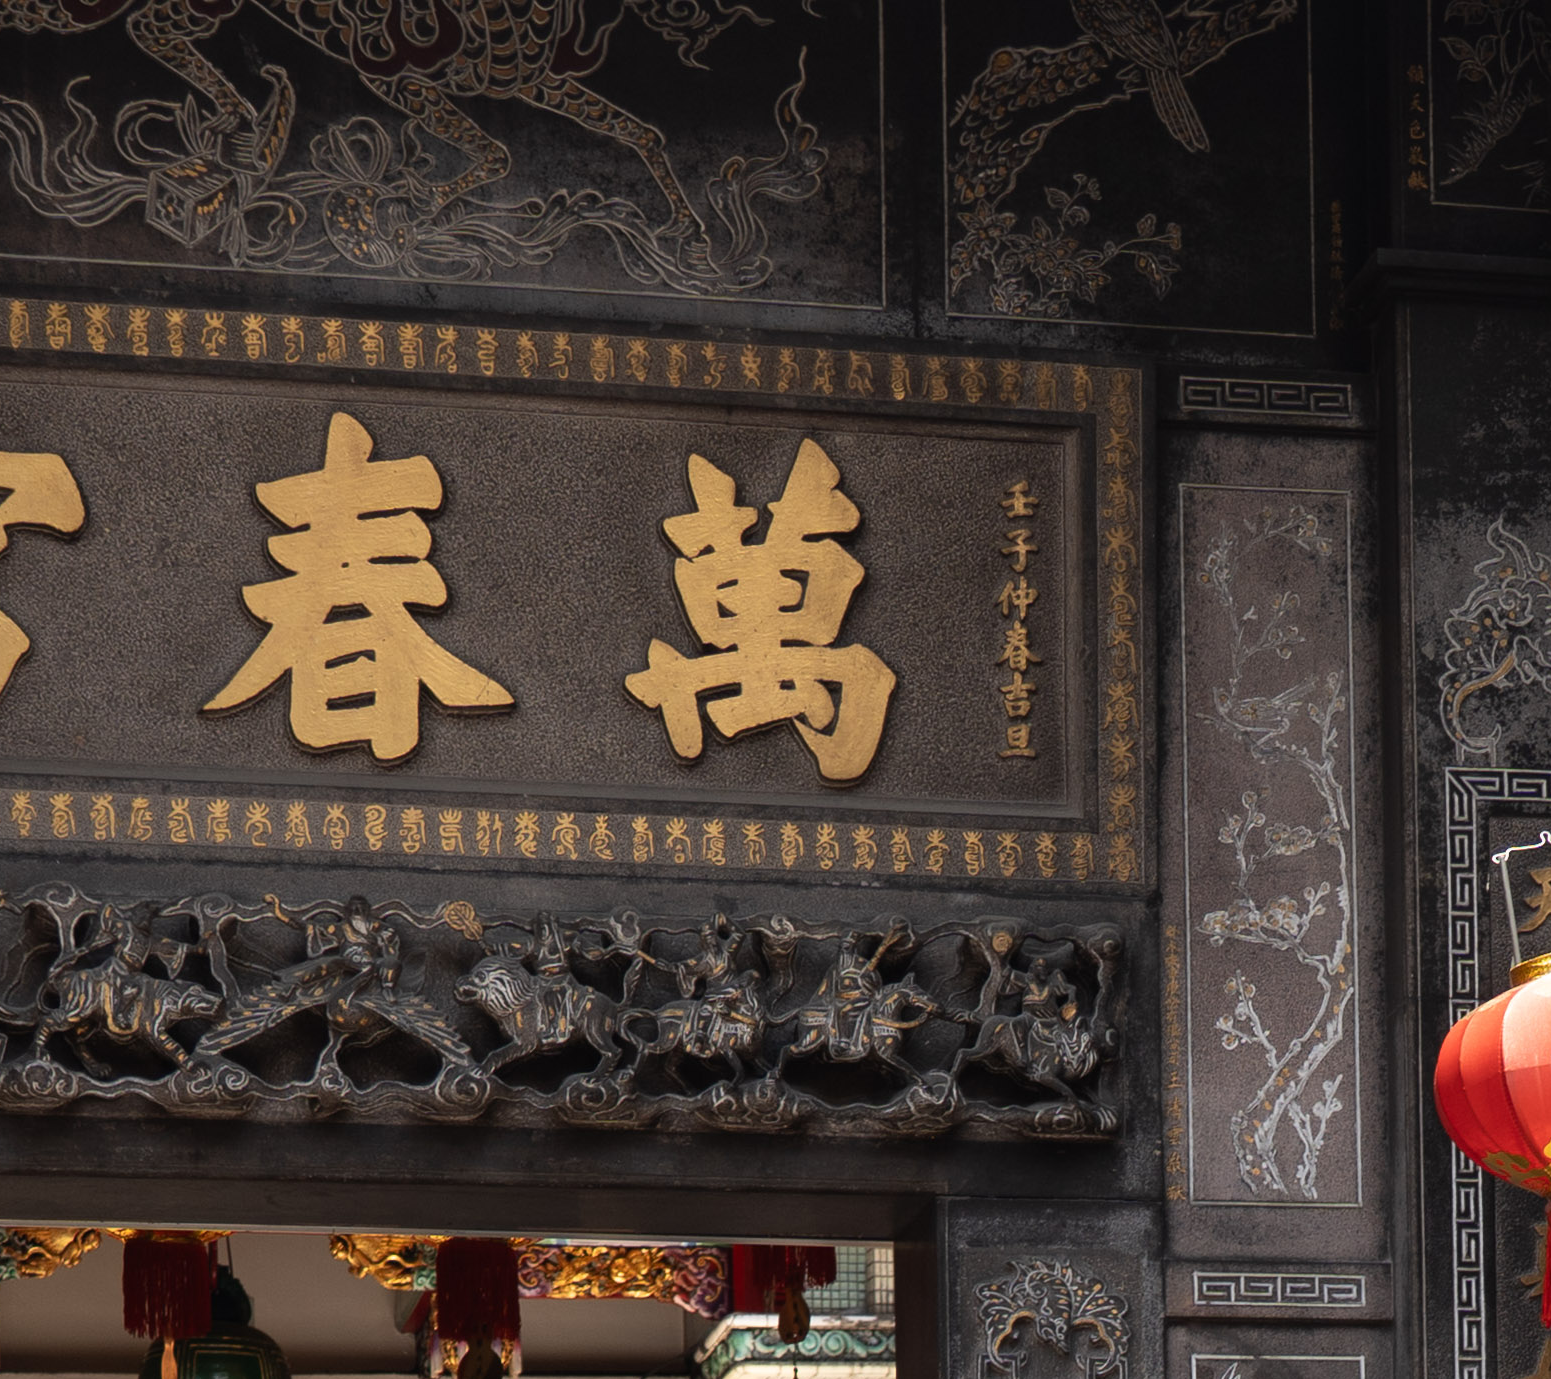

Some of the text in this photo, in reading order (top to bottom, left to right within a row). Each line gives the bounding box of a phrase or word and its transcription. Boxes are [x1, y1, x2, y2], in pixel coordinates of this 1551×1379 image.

[998, 480, 1042, 759] 壬子仲春吉旦
